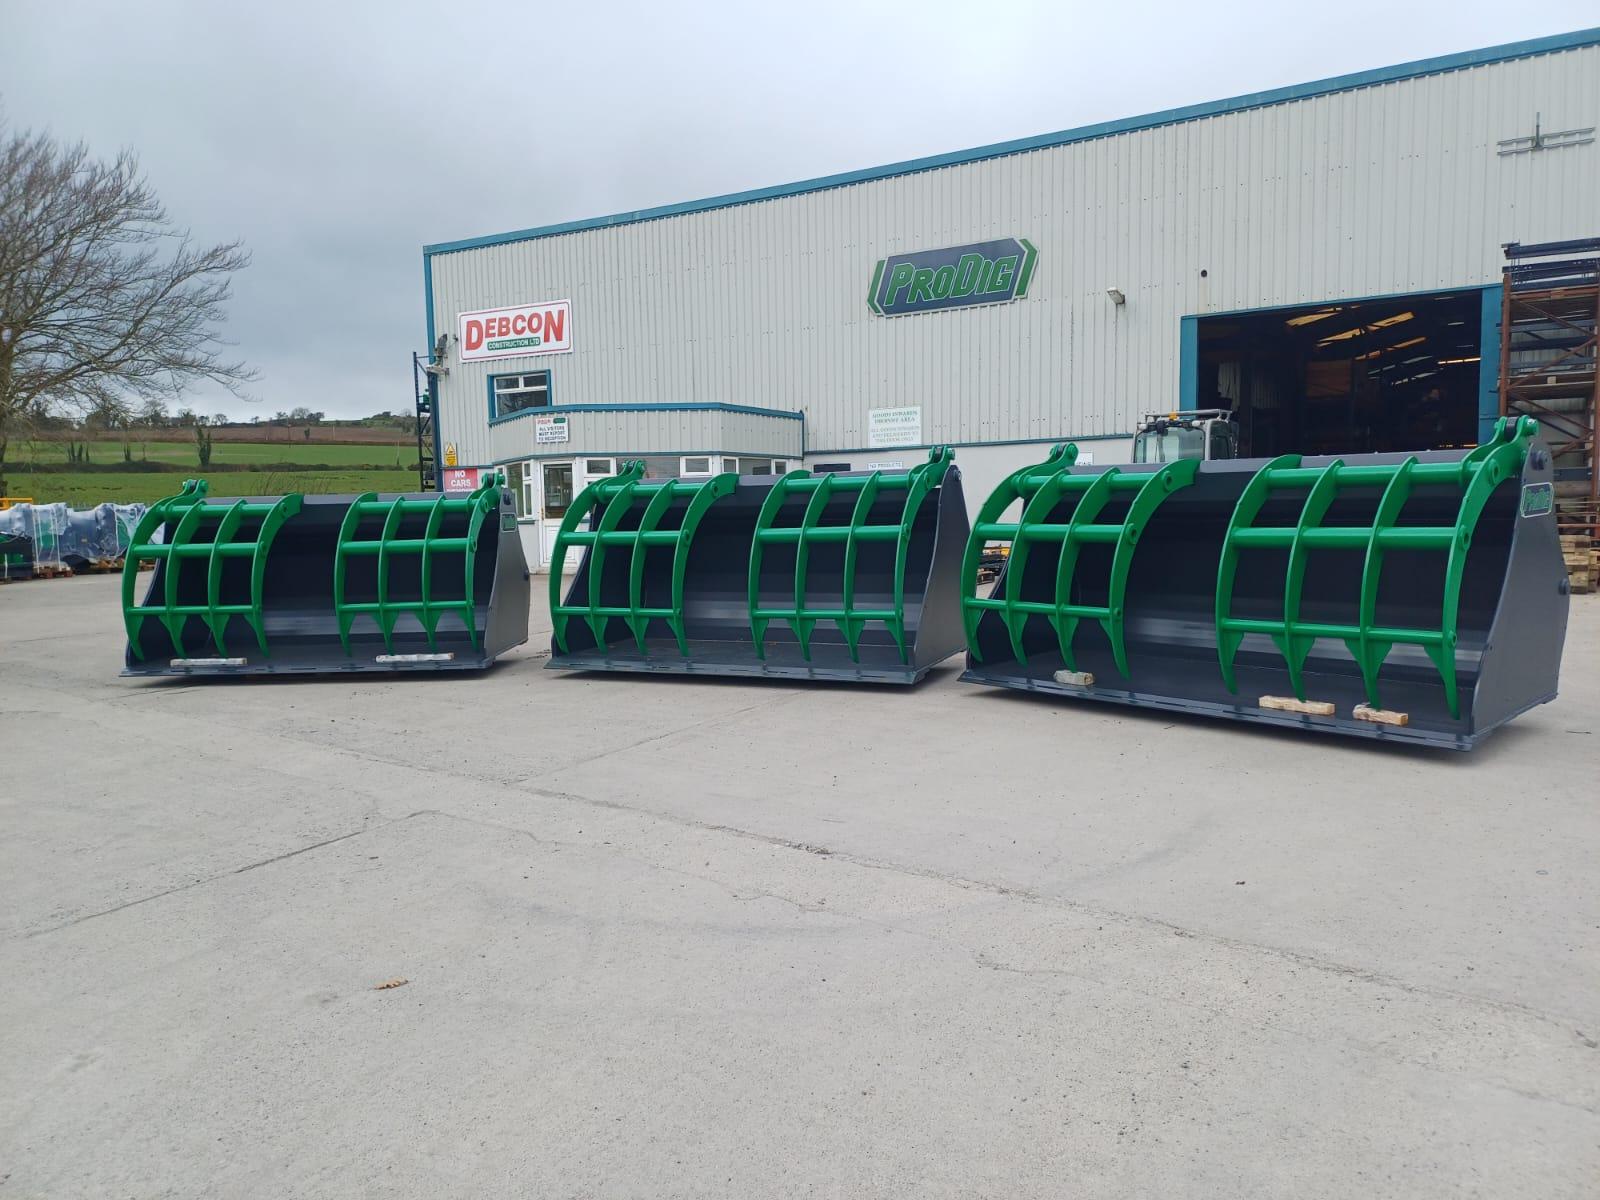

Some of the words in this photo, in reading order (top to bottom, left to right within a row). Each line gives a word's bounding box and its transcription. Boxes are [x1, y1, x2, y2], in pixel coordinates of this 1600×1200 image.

[465, 309, 565, 351] DEBCON
[488, 339, 529, 350] CONSTRUCTION
[529, 338, 540, 346] LTD
[454, 470, 466, 478] NO
[450, 479, 472, 487] CARS
